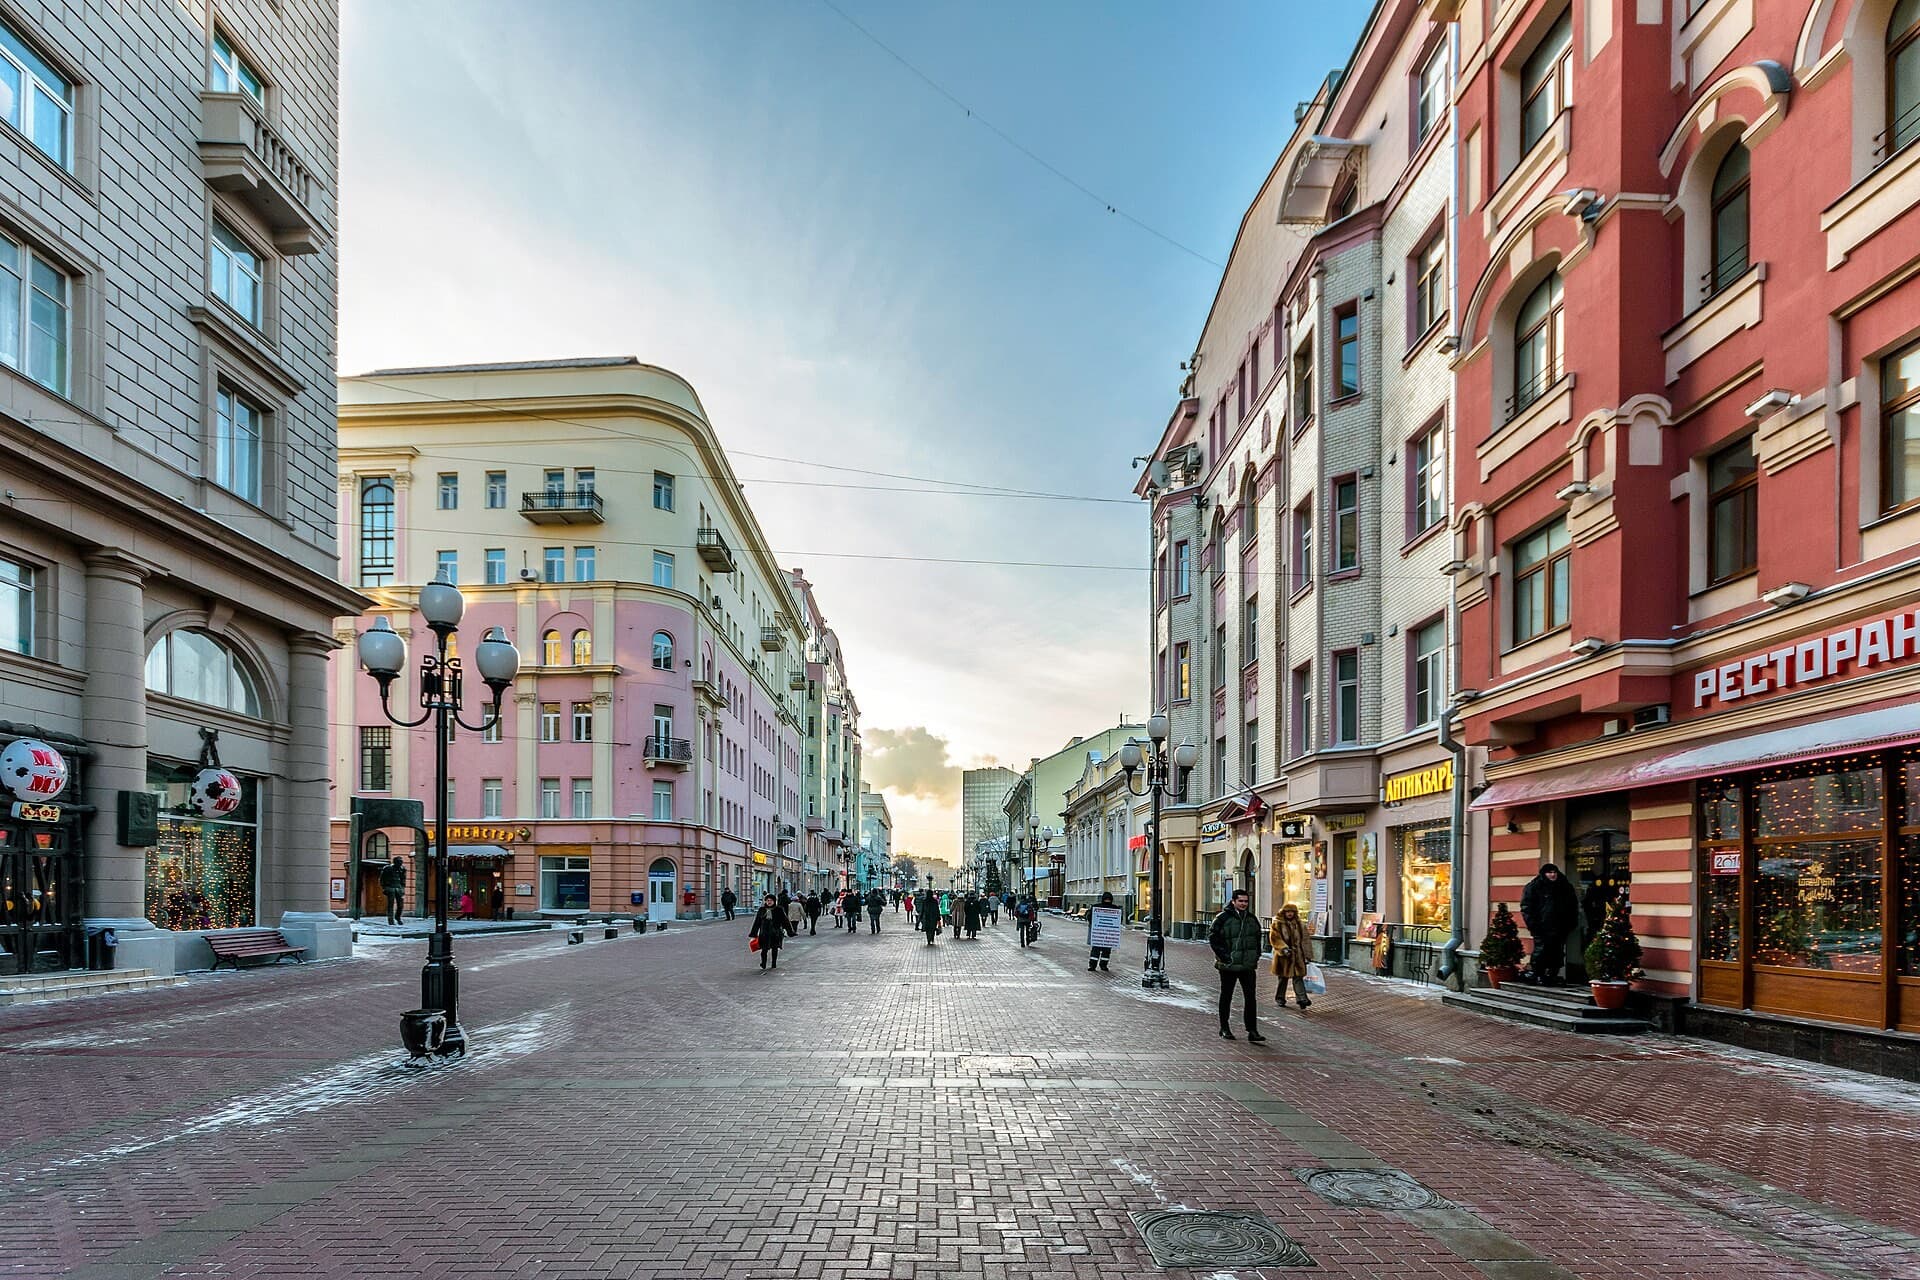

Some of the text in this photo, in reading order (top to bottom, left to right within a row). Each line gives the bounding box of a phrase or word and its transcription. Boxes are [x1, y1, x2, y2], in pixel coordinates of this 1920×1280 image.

[1694, 609, 1920, 708] РЕСТОРАН
[1385, 760, 1454, 802] АНТИКВАРЪ
[22, 807, 58, 818] КАФЕ
